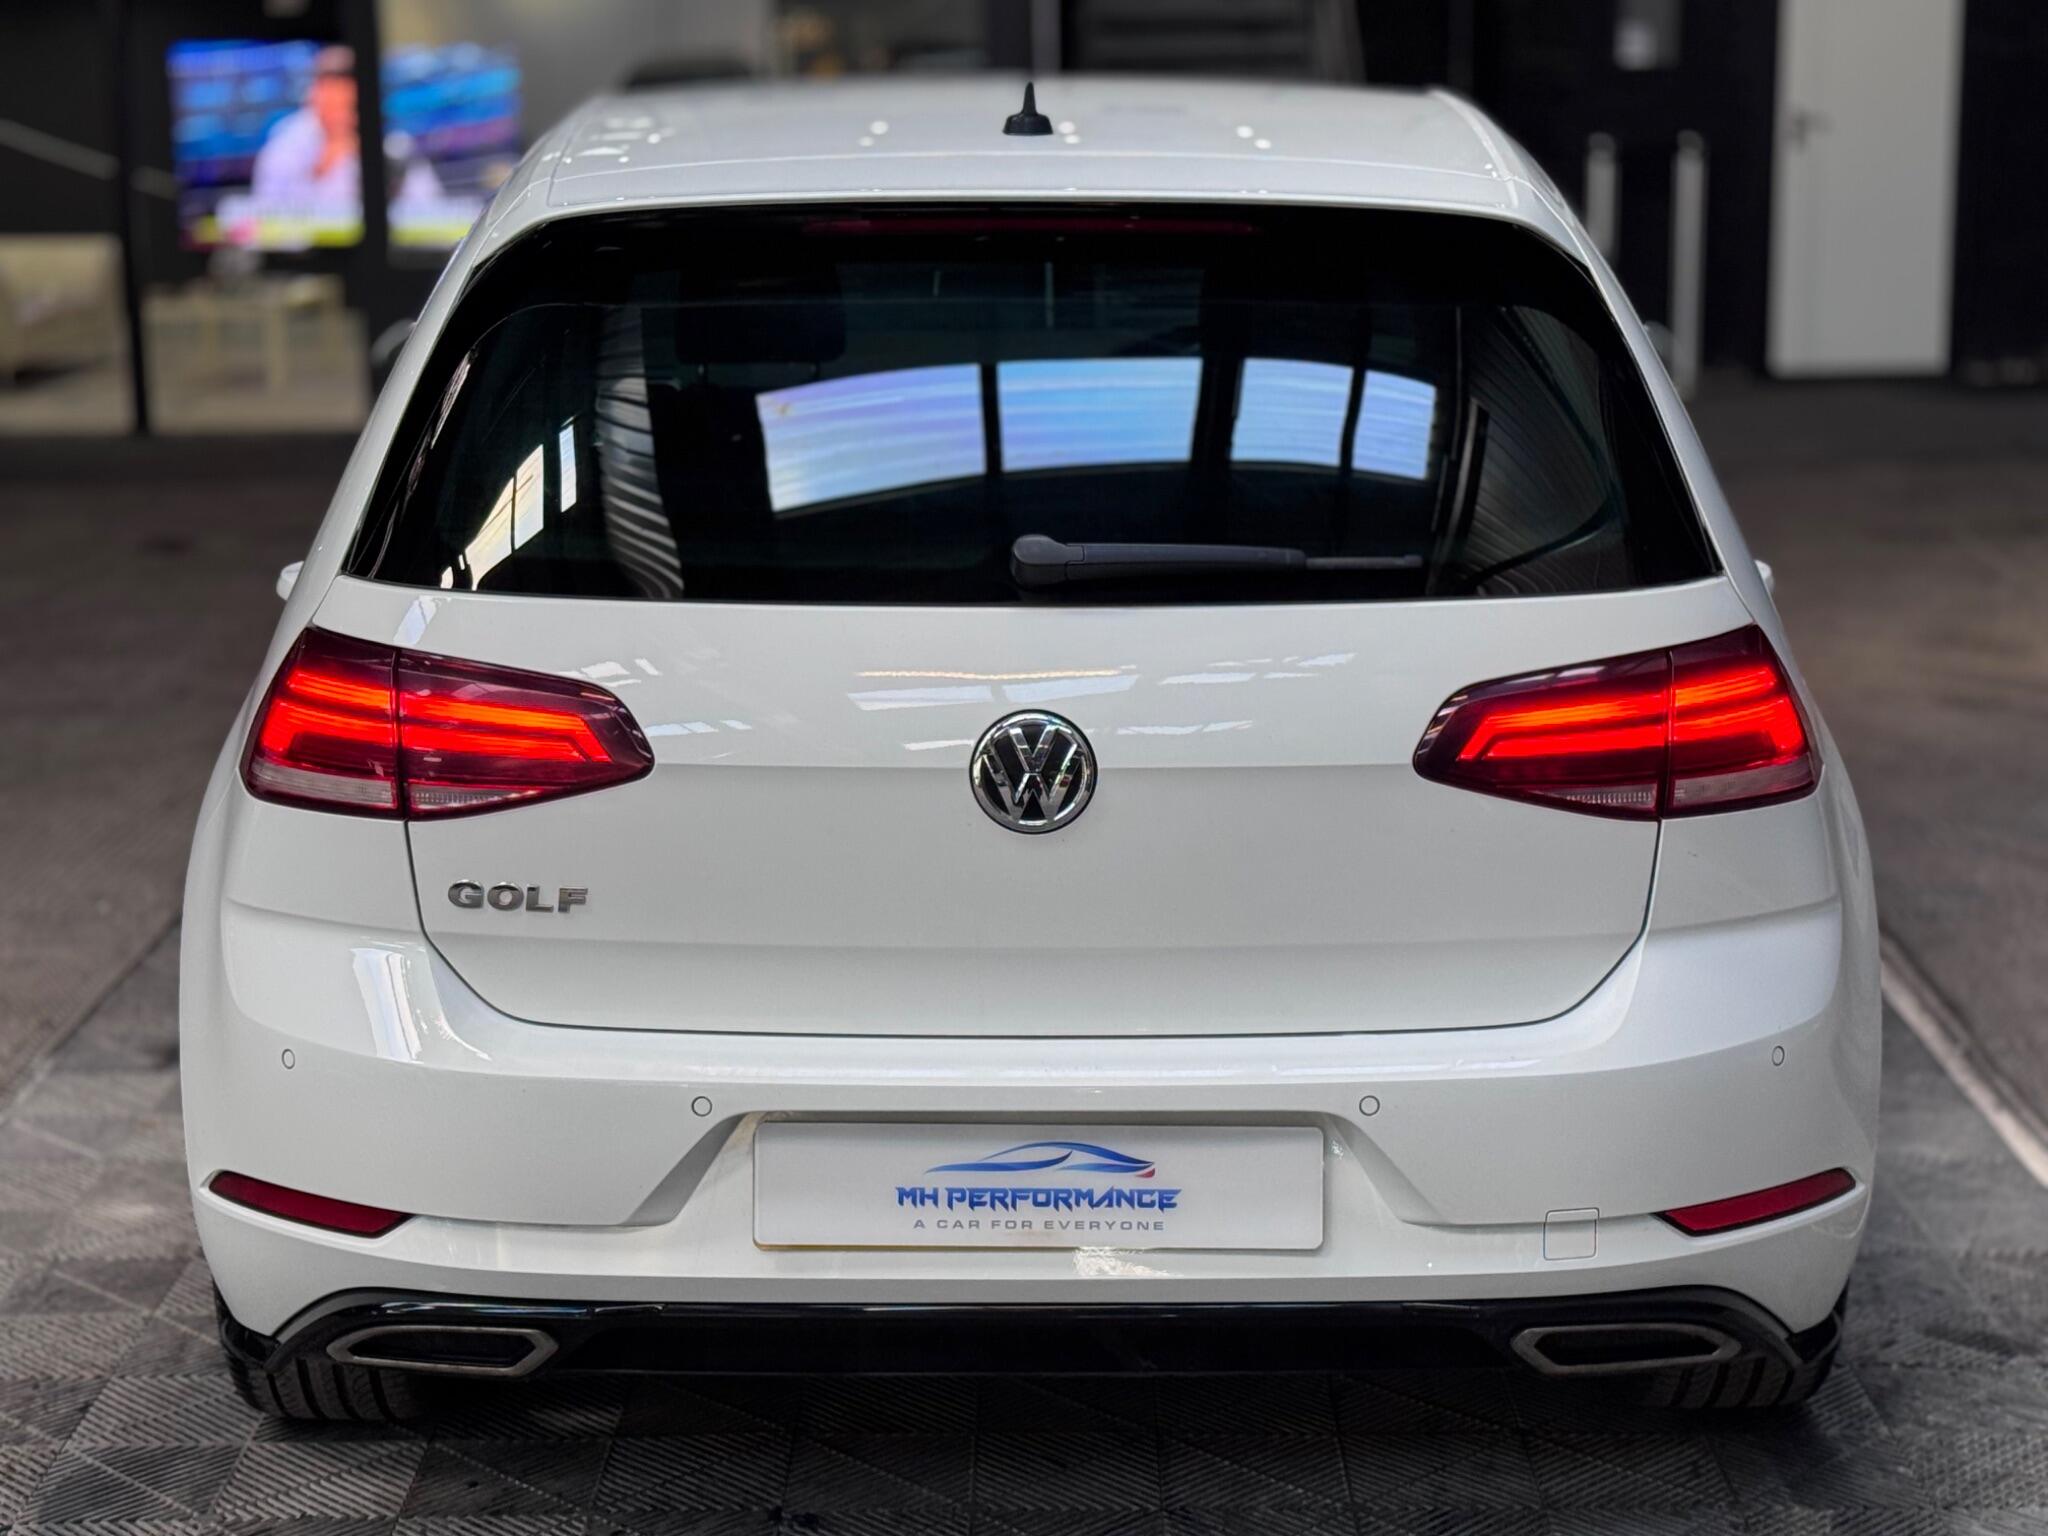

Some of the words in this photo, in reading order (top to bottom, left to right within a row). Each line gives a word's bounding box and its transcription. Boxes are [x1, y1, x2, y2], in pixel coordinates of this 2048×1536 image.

[981, 724, 1086, 822] VW
[447, 880, 589, 913] GOLF
[895, 1187, 939, 1208] MH
[945, 1186, 1182, 1213] PERFORMANCE
[913, 1219, 926, 1229] A
[936, 1219, 980, 1229] CAR
[991, 1219, 1033, 1230] FOR
[1043, 1220, 1165, 1231] EVERYONE
